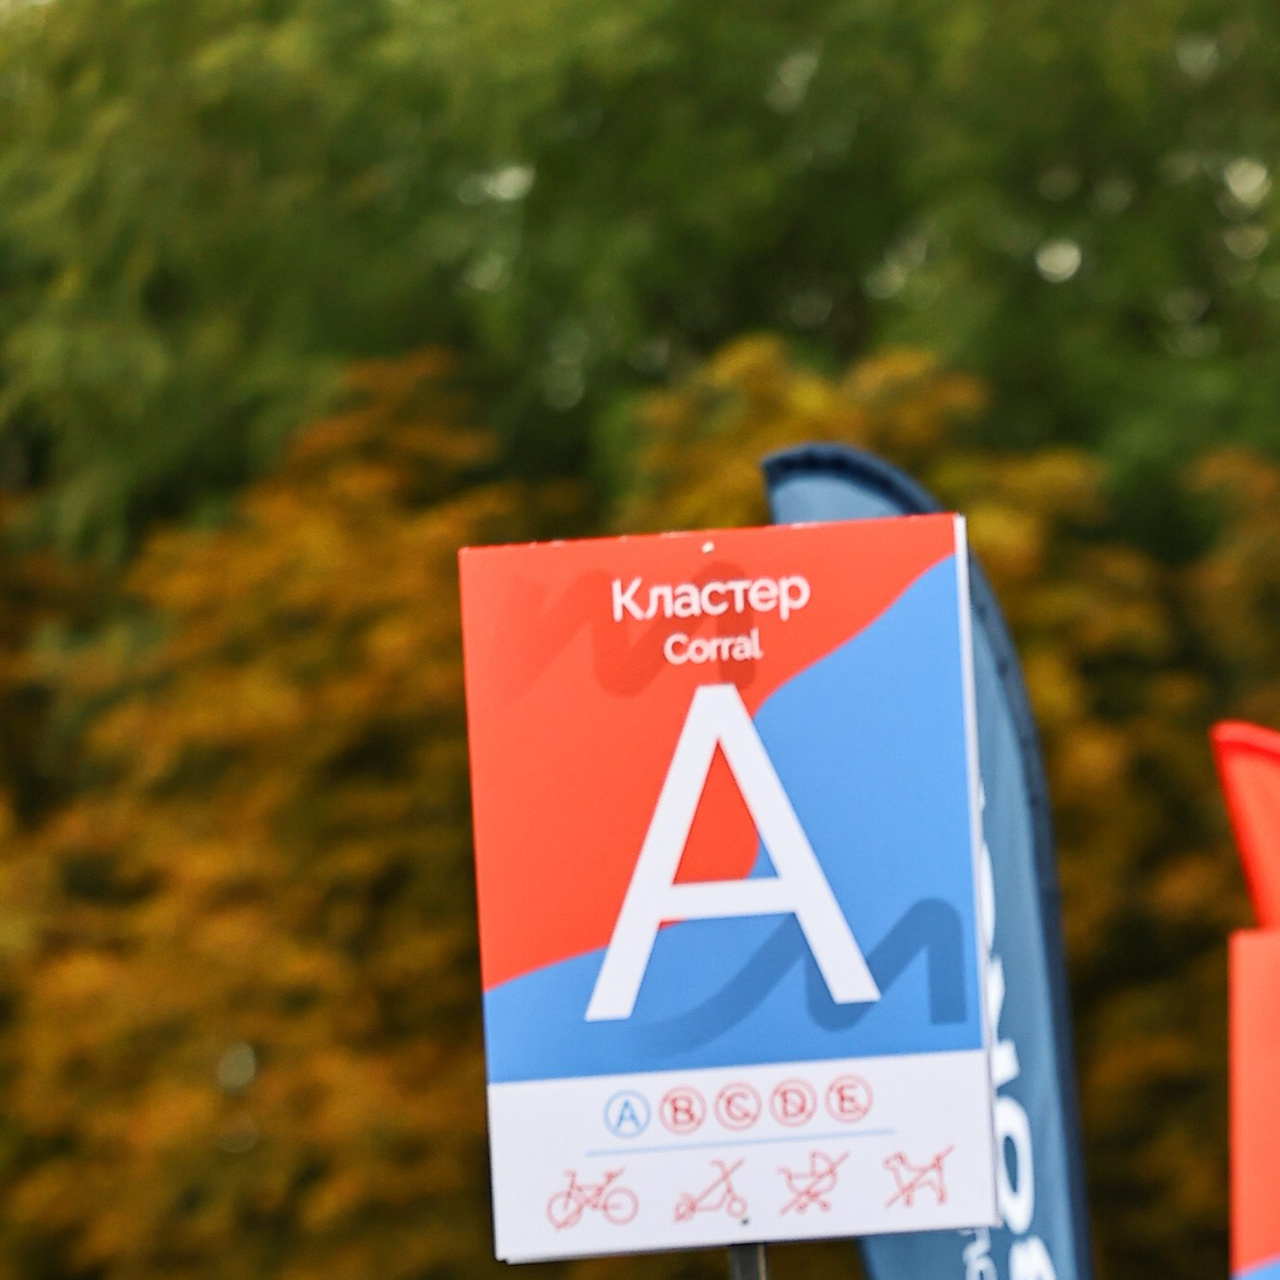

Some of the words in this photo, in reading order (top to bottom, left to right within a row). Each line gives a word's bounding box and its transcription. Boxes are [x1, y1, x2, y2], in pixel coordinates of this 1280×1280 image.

[612, 575, 811, 622] Кластер
[663, 627, 764, 666] Corral
[585, 683, 880, 1022] A
